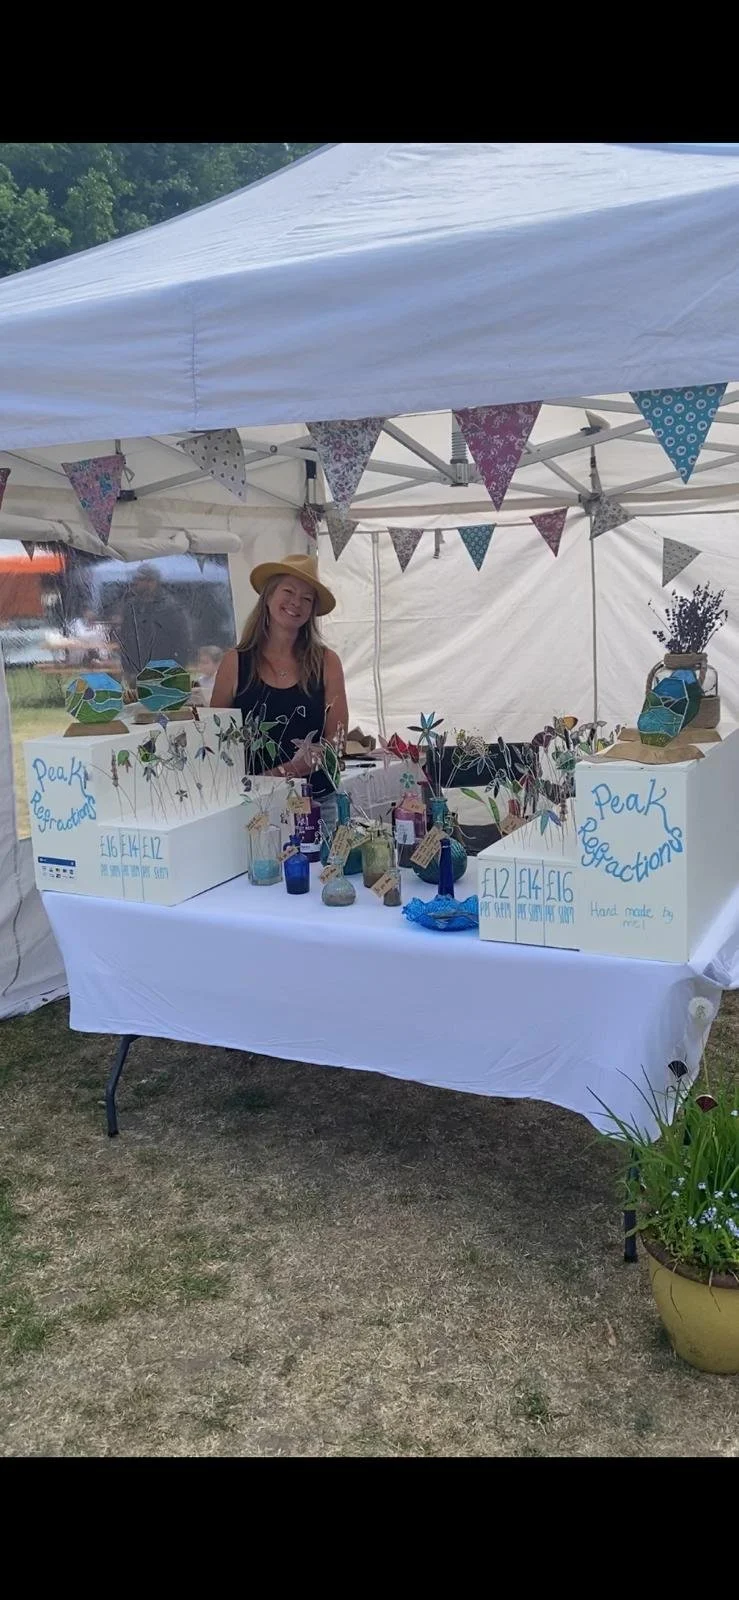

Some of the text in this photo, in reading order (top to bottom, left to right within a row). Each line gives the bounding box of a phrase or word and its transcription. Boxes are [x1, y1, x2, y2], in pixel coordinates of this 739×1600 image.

[32, 756, 88, 794] Peak
[30, 789, 96, 833] Refractions
[591, 778, 667, 822] Peak
[100, 835, 118, 858] £16
[121, 834, 140, 858] £14
[143, 836, 165, 860] £12
[577, 816, 683, 883] Refractions
[481, 867, 510, 899] £12
[517, 867, 542, 900] £14
[546, 870, 574, 903] £16
[590, 900, 674, 922] Hand made by
